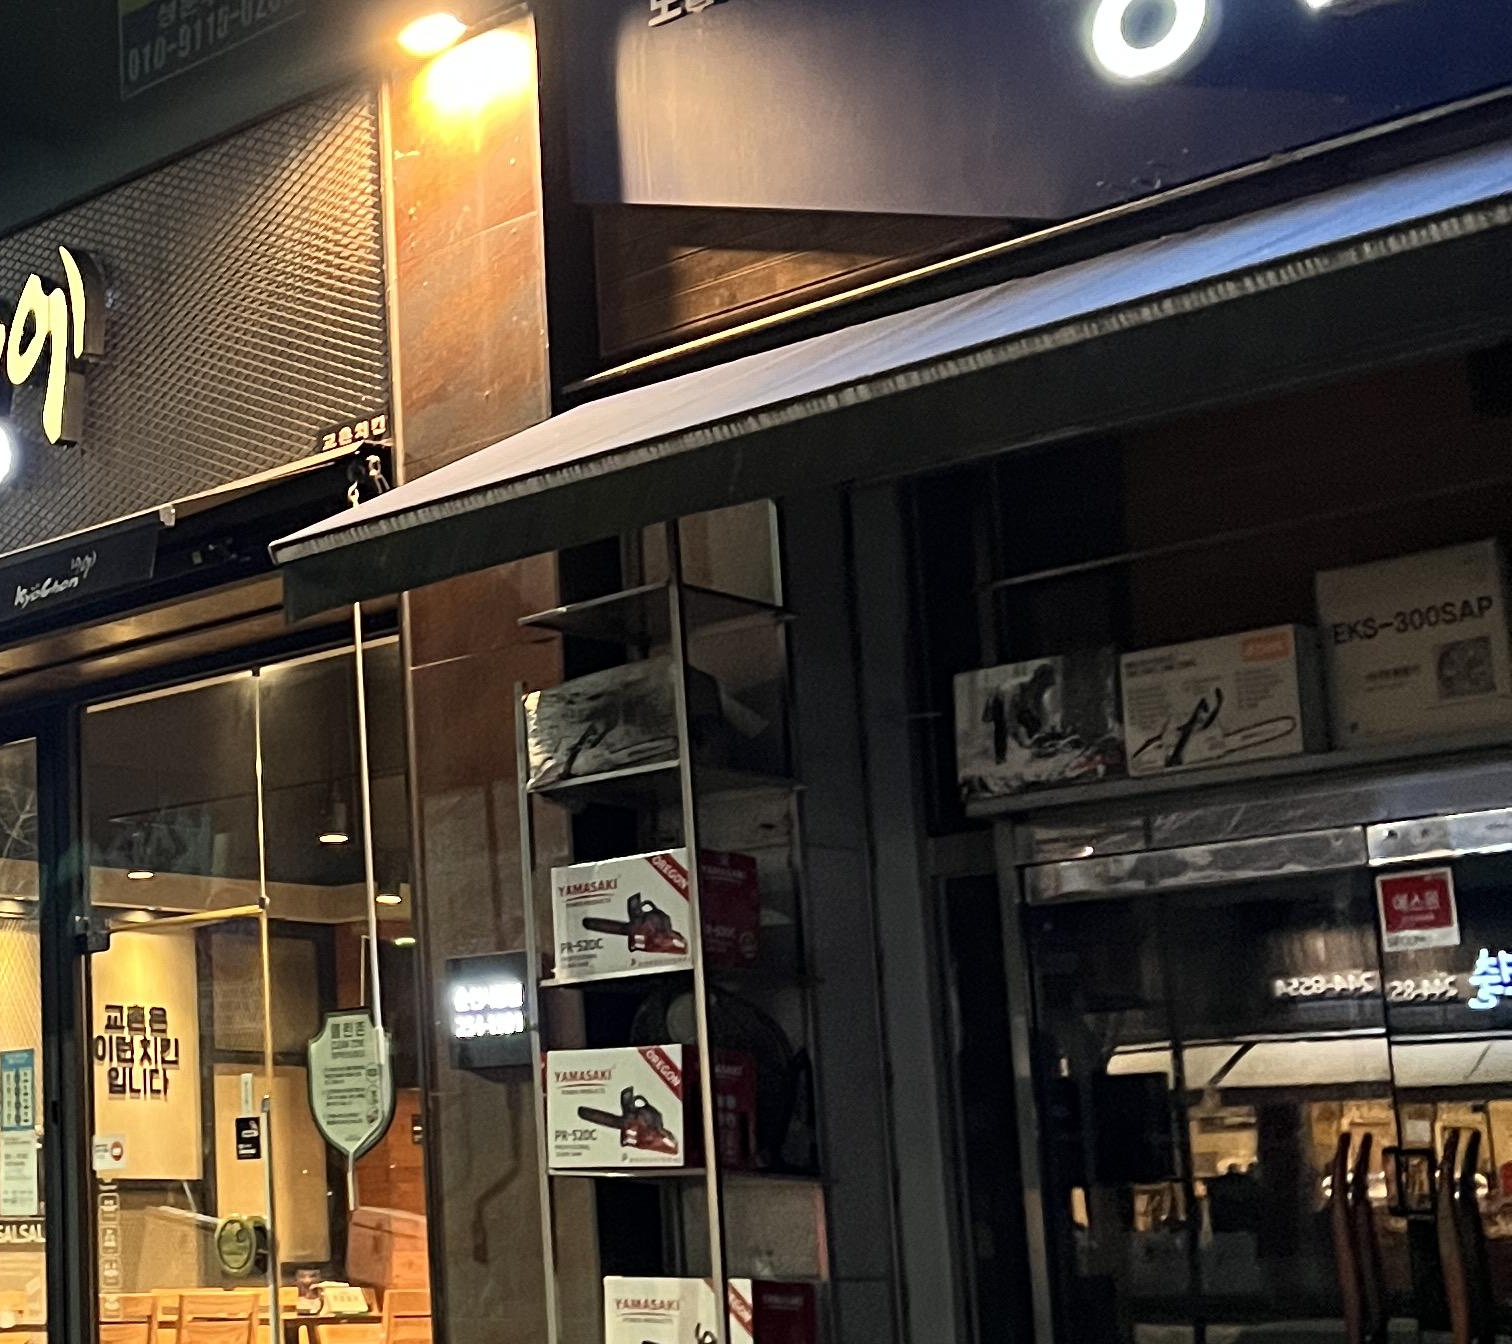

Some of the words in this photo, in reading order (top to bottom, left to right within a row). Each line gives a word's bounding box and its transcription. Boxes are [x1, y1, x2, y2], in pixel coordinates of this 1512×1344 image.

[1334, 595, 1494, 645] EKS-300SAP
[558, 878, 618, 898] YAMASAKI
[554, 1070, 612, 1083] YAMASAKI
[646, 1049, 681, 1086] OREGON
[108, 1067, 169, 1097] 입니다
[615, 1298, 680, 1311] YAMASAKI
